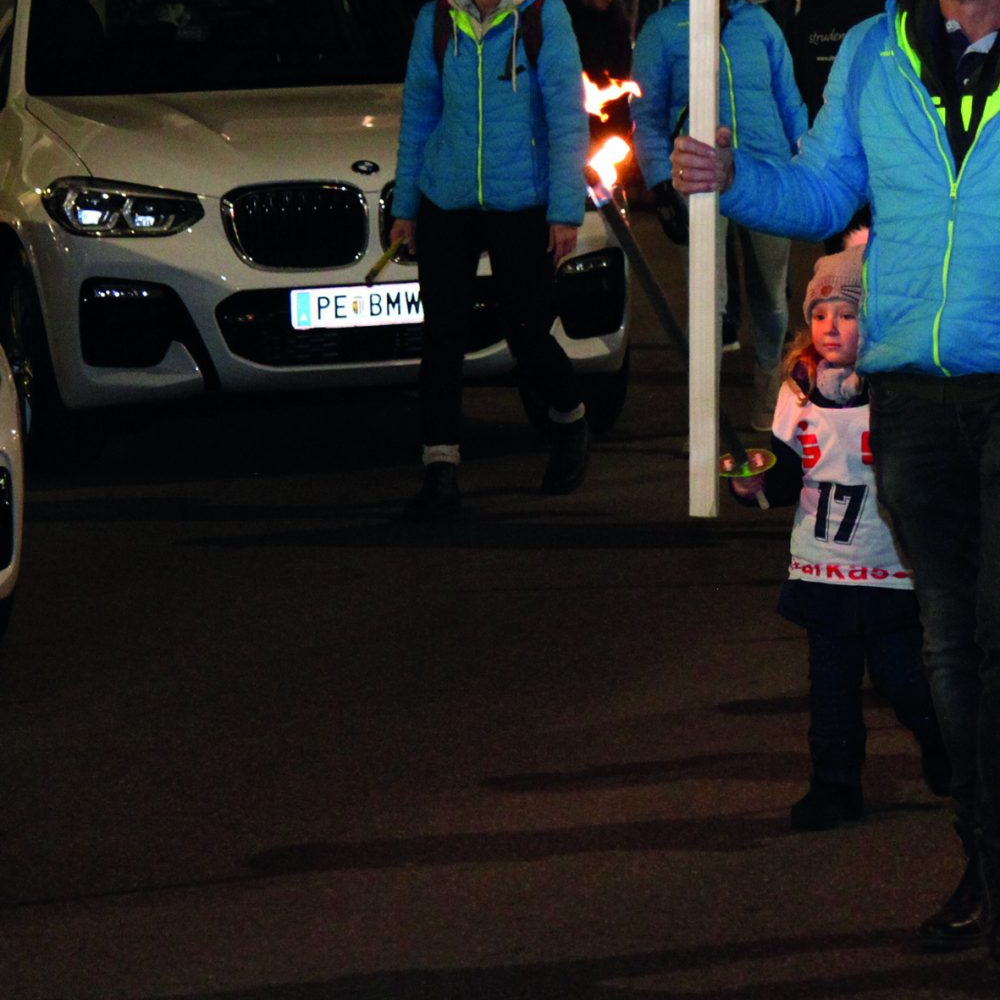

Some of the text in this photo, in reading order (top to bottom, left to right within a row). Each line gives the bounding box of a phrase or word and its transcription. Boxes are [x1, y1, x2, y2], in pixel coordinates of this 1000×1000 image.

[317, 294, 347, 320] PE
[369, 291, 421, 316] BMW
[814, 482, 870, 545] 17
